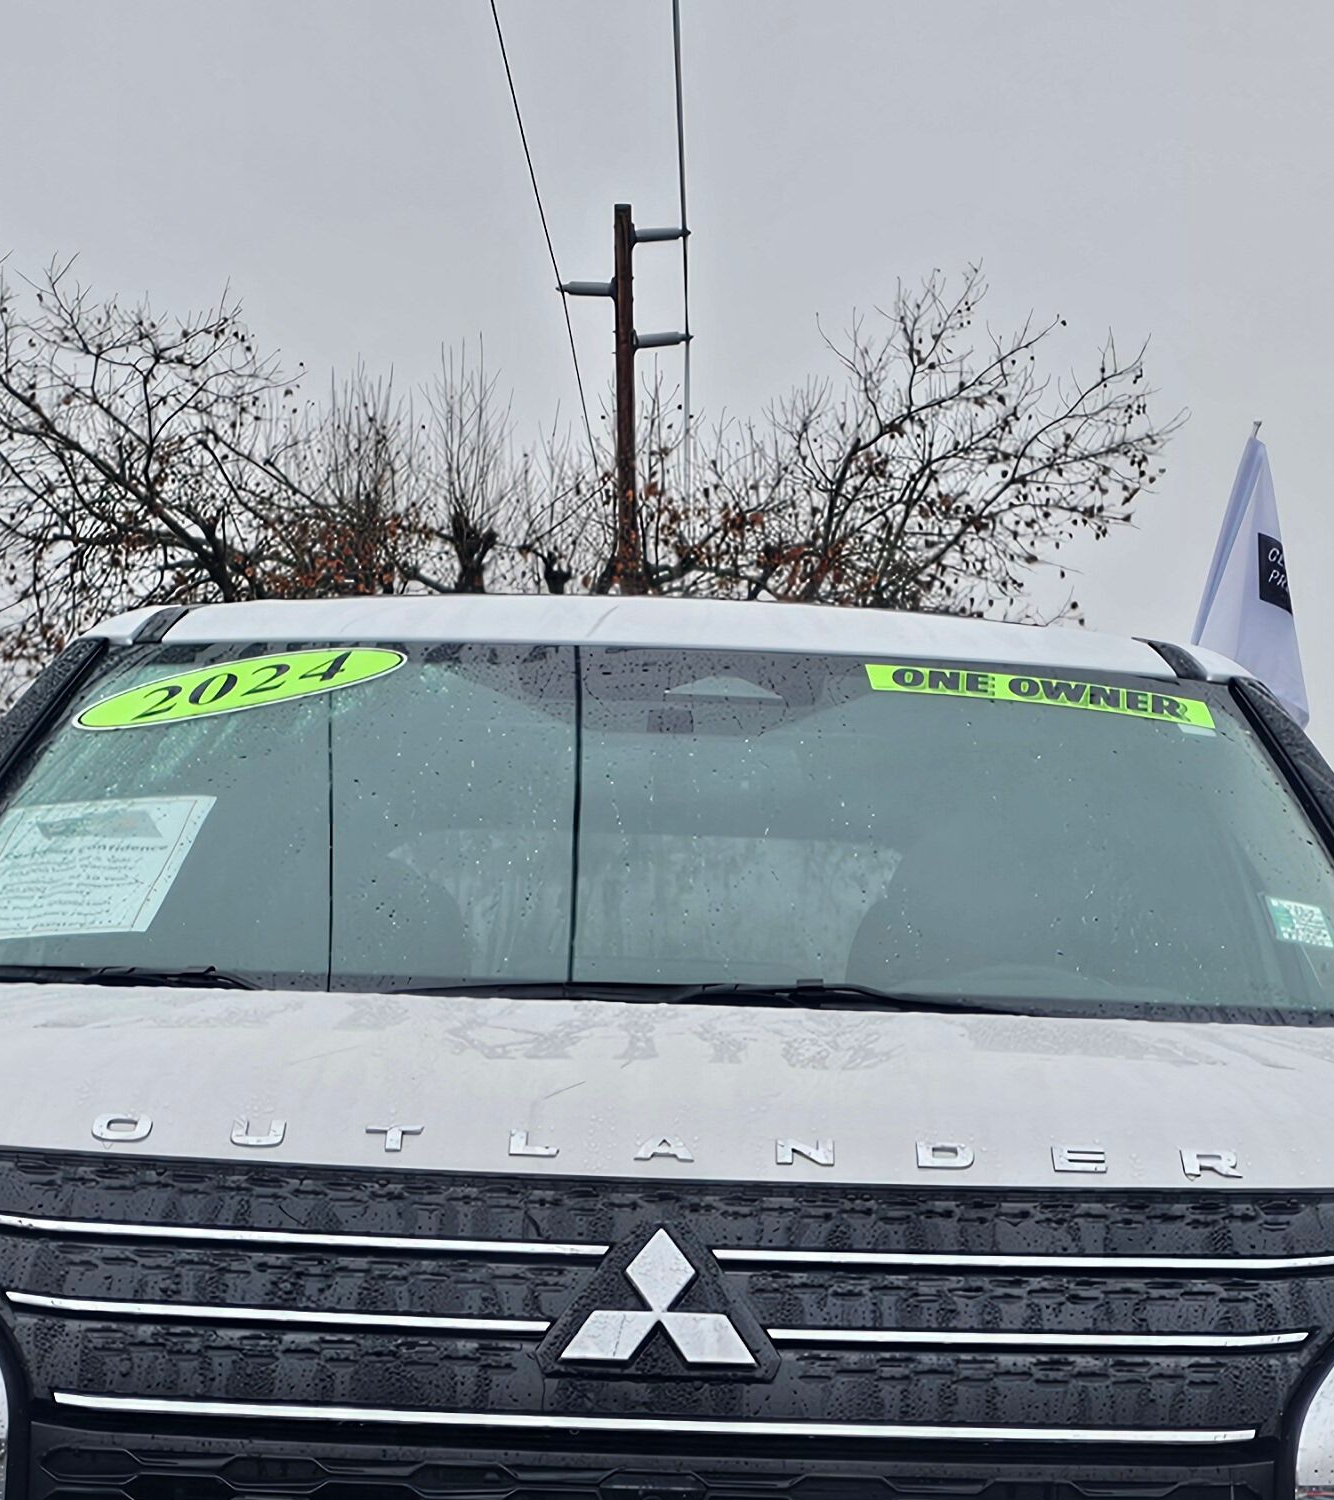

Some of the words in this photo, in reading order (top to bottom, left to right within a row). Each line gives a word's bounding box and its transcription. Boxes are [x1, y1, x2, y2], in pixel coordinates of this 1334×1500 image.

[130, 650, 353, 721] 2024
[892, 667, 996, 693] ONE
[1008, 677, 1191, 722] OWNER
[90, 1111, 1244, 1180] OUTLANDER
